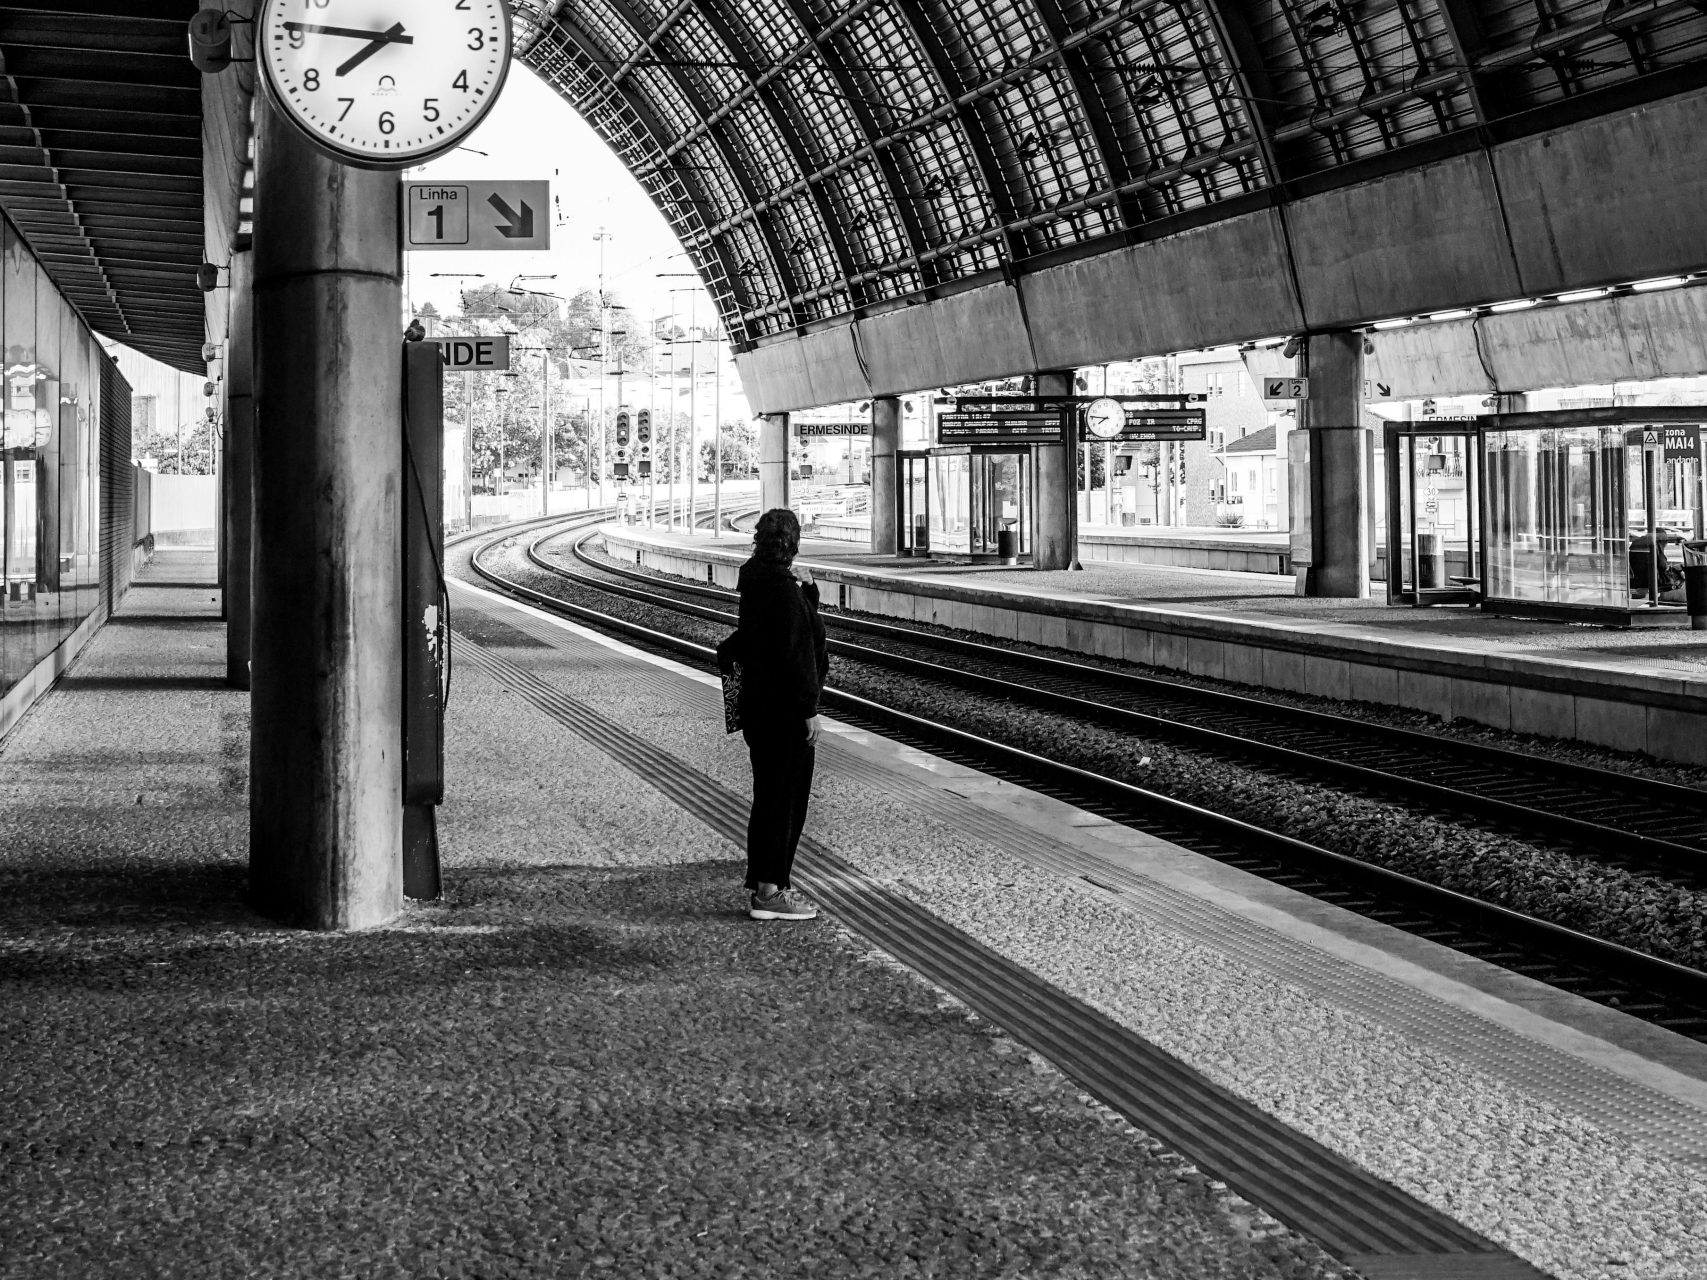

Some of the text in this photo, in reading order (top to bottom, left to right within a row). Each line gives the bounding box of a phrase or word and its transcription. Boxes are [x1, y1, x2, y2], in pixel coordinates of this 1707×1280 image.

[288, 28, 305, 50] 9
[467, 27, 484, 51] 3
[303, 68, 320, 92] 8
[452, 69, 470, 93] 4
[337, 97, 355, 122] 7
[423, 98, 440, 122] 5
[378, 111, 395, 134] 6
[419, 188, 458, 200] Linha
[427, 205, 444, 239] 1
[1293, 385, 1302, 397] 2
[800, 424, 869, 435] ERMESINDE
[1665, 436, 1695, 450] MAI4
